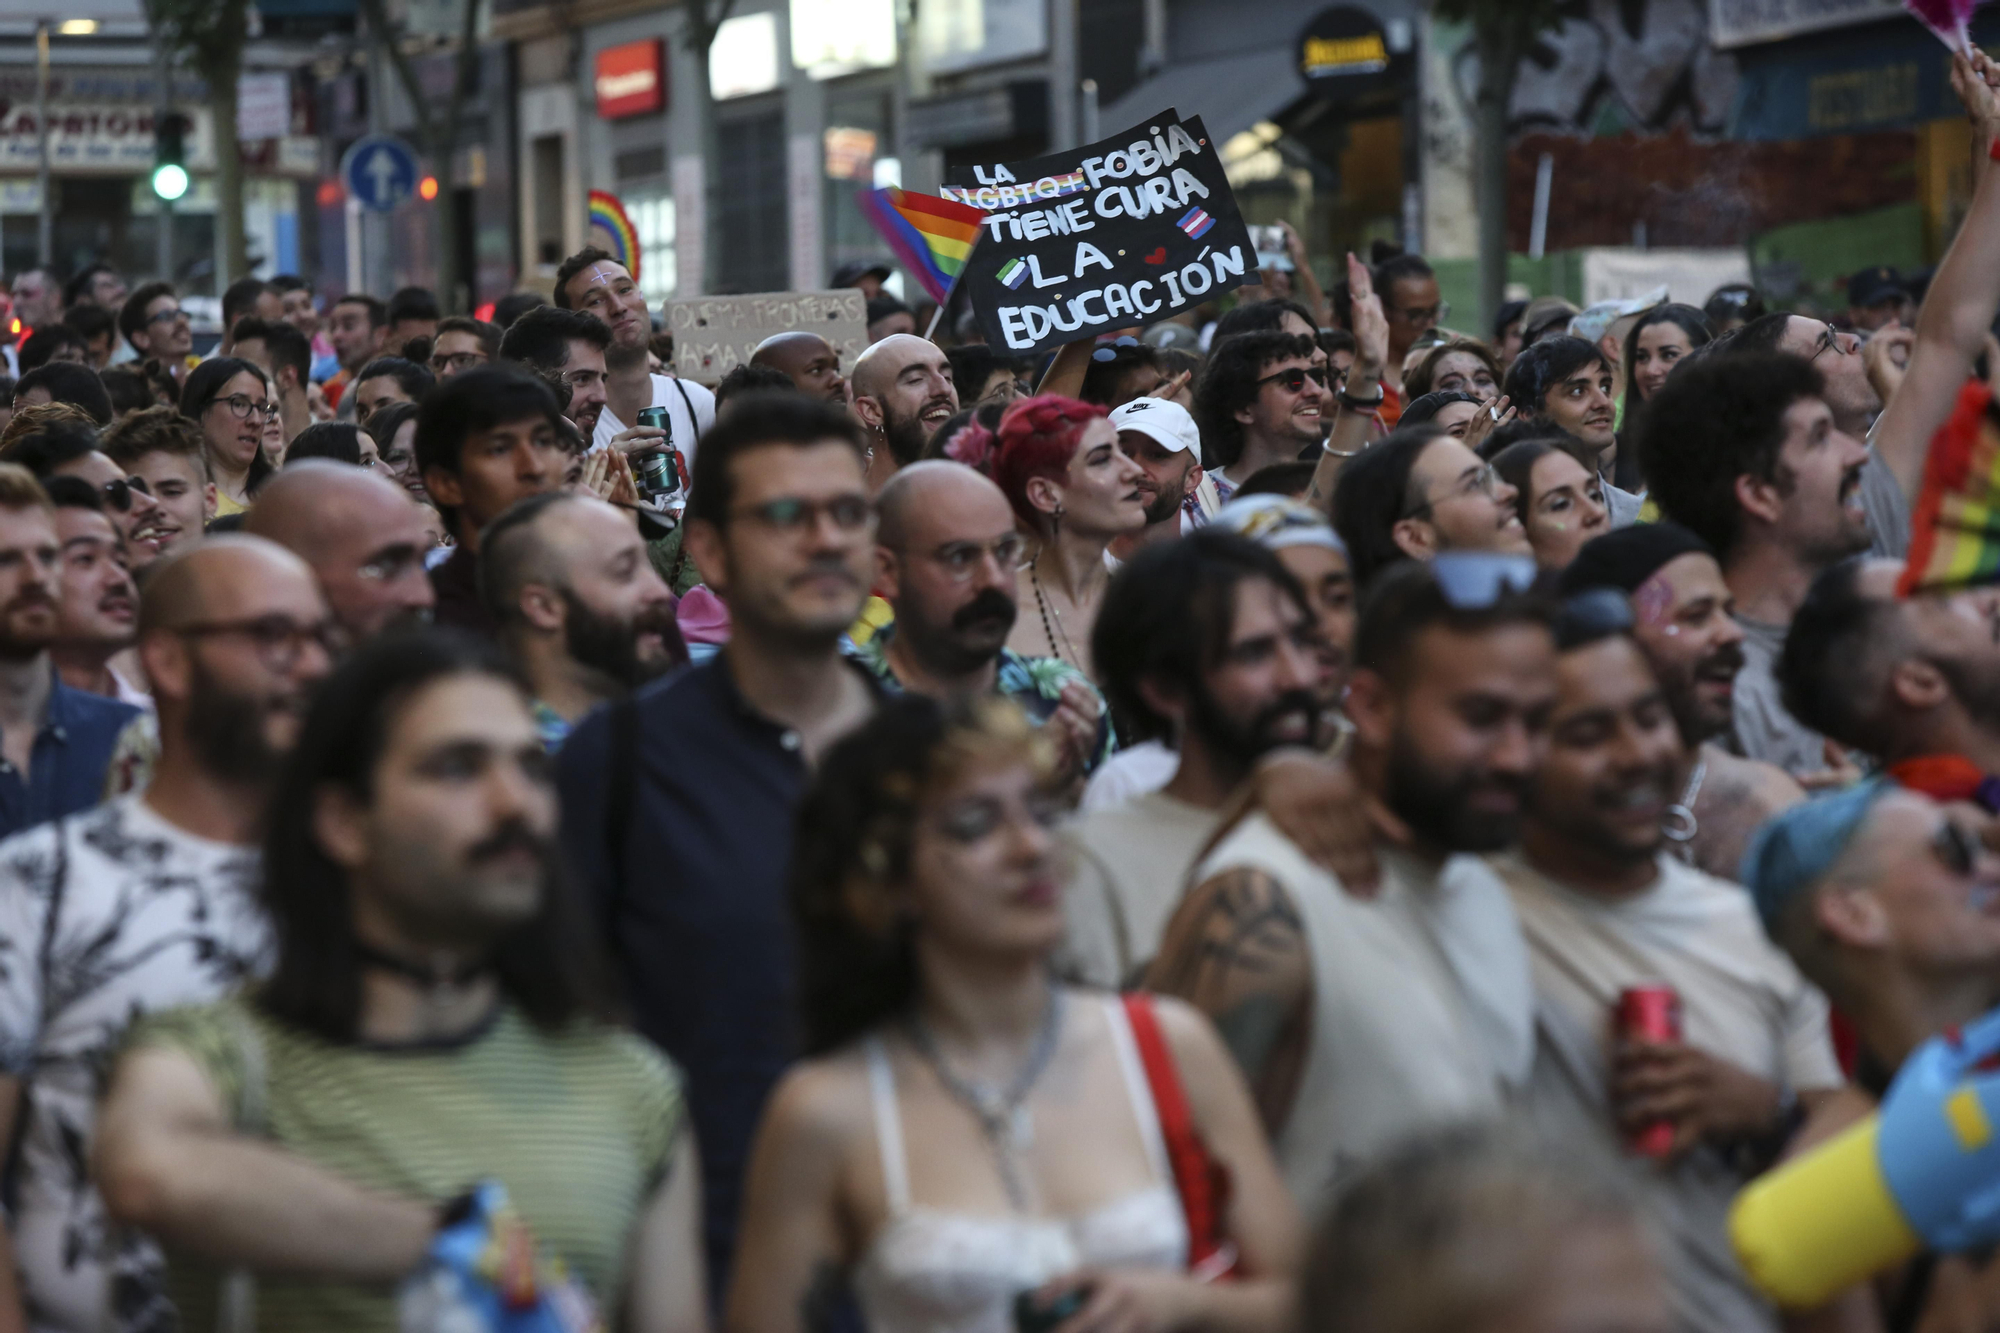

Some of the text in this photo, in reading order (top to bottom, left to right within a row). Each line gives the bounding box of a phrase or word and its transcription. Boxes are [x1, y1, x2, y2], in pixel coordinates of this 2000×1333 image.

[973, 163, 1017, 185] LA
[1094, 168, 1210, 220] CURA
[1027, 242, 1115, 289] LA
[997, 245, 1246, 350] EDUCACIÓN
[680, 341, 739, 372] AMA
